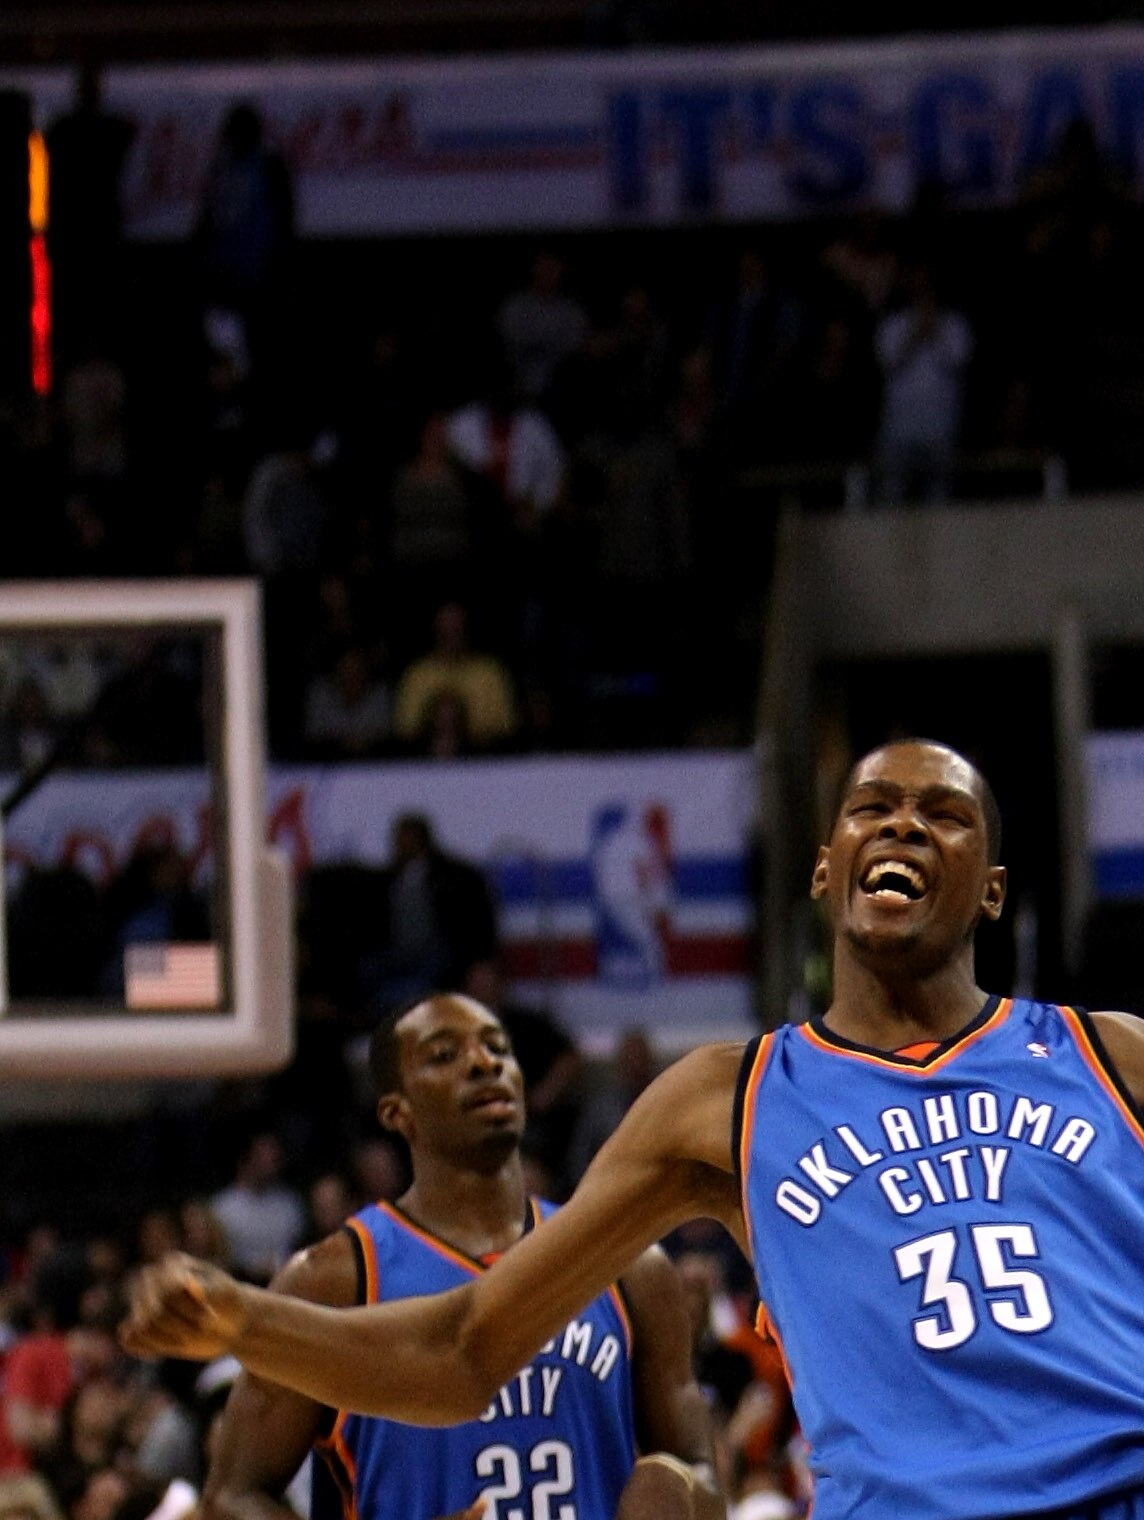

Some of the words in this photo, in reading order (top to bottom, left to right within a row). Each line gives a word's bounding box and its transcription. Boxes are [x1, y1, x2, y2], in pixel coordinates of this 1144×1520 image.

[608, 82, 869, 209] IT'S
[775, 1090, 1096, 1227] OKLAHOMA
[878, 1144, 1012, 1216] CITY
[891, 1222, 1055, 1351] 35
